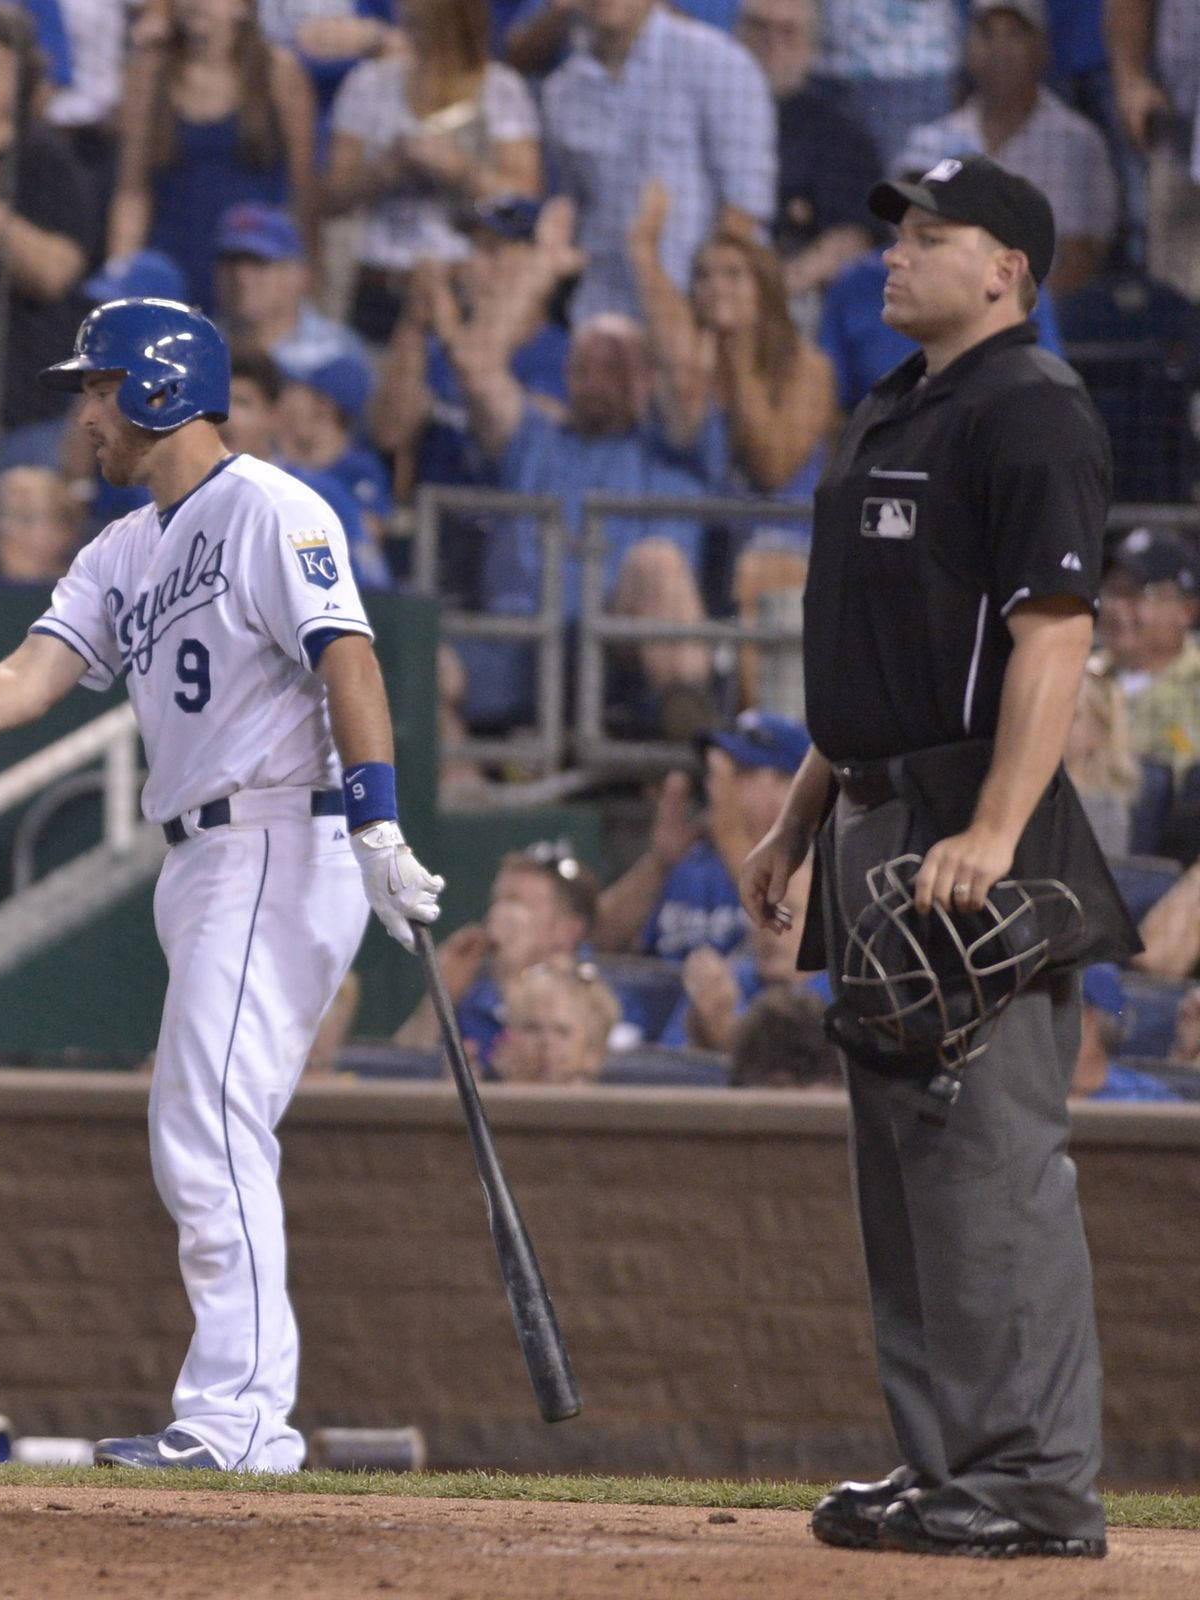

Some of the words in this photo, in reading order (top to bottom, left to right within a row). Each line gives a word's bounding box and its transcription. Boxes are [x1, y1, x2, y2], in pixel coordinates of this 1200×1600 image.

[300, 552, 336, 580] KC
[174, 638, 210, 713] 9
[352, 782, 365, 799] 9
